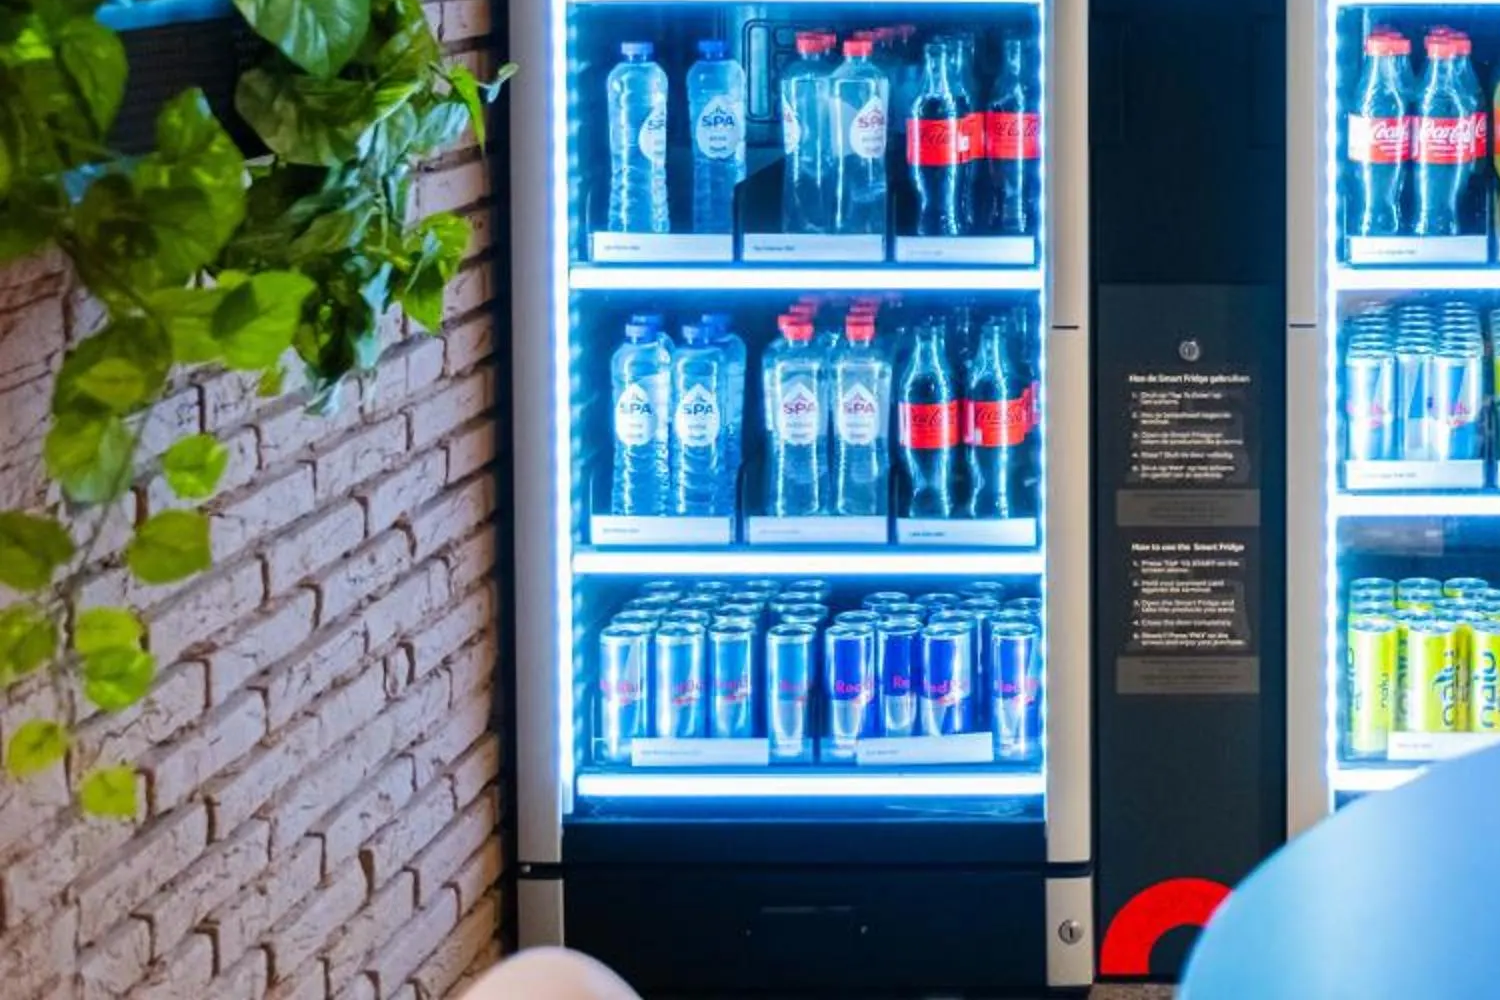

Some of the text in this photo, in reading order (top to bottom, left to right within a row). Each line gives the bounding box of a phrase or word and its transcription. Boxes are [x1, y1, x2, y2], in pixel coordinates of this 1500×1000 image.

[701, 115, 735, 128] SPA
[683, 403, 714, 415] SPA
[1473, 651, 1498, 729] nalu
